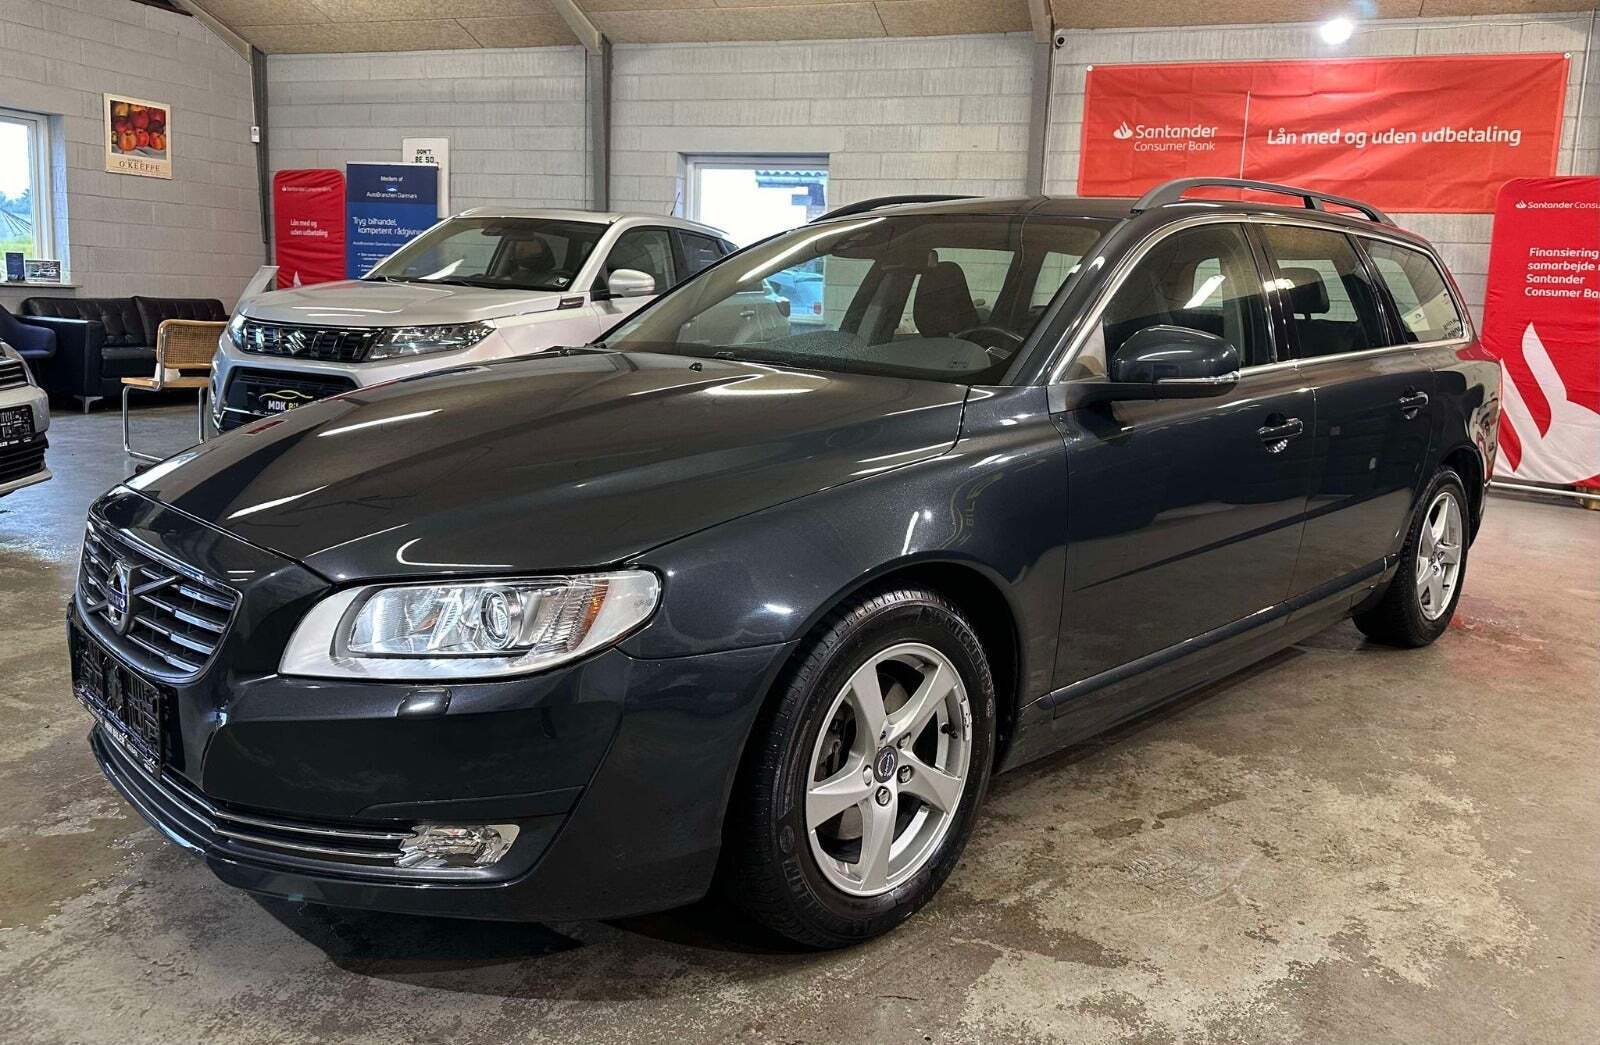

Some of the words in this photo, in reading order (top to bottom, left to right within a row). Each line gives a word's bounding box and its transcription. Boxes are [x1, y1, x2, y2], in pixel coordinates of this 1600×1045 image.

[1135, 124, 1218, 139] Santander
[1267, 127, 1297, 145] Lån
[1301, 128, 1341, 144] med
[1344, 130, 1367, 148] og
[1371, 127, 1417, 144] uden
[1421, 125, 1521, 146] udbetaling
[1133, 140, 1187, 151] Consumer
[1188, 141, 1215, 151] Bank
[1527, 201, 1573, 209] Santander
[352, 216, 367, 227] Tryg
[357, 227, 393, 235] kompetent
[1529, 247, 1599, 260] Finansiering
[1527, 260, 1595, 273] samarbejde
[1525, 273, 1585, 285] Santander
[1524, 286, 1581, 298] Consumer
[1583, 288, 1600, 299] Ba
[267, 400, 286, 411] MDK
